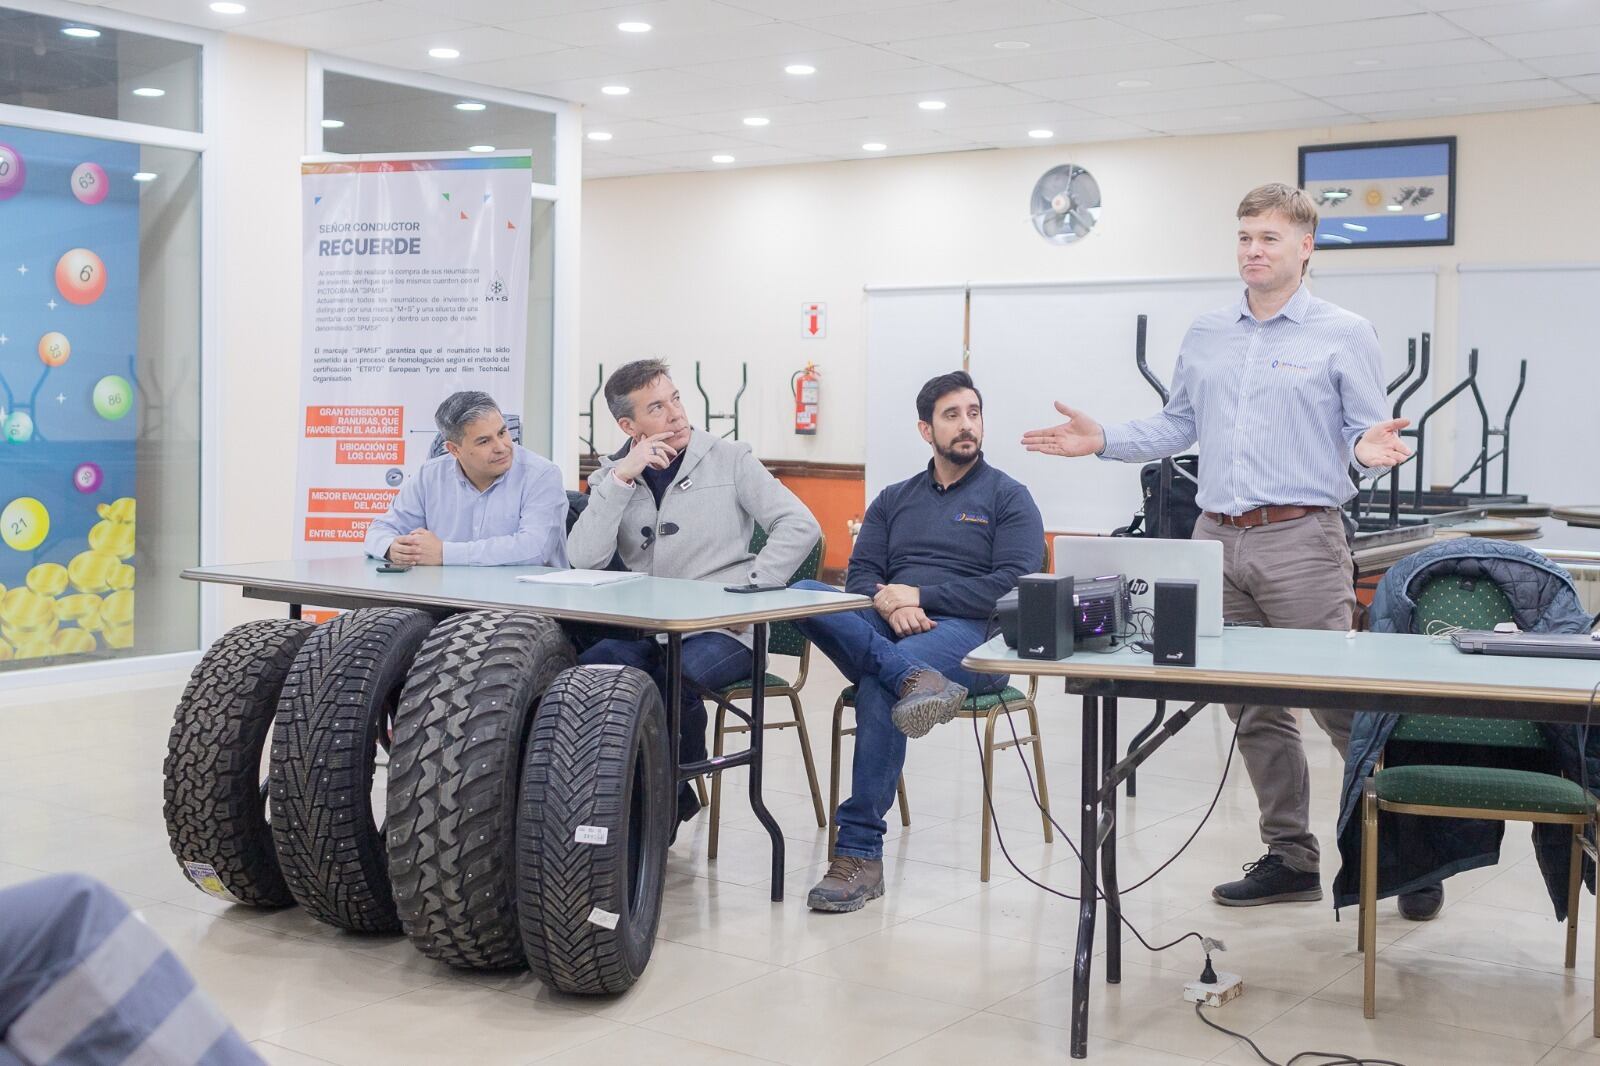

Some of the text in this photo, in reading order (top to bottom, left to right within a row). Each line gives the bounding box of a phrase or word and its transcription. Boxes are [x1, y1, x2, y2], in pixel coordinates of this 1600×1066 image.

[79, 172, 95, 189] 63
[319, 222, 420, 234] SEÑOR CONDUCTOR
[319, 238, 421, 256] RECUERDE
[80, 265, 93, 282] 6
[385, 347, 416, 355] garantiza
[397, 356, 445, 365] homologación
[388, 366, 421, 374] European
[425, 366, 440, 374] Tyre
[320, 408, 399, 416] GRAN DENSIDAD DE
[338, 417, 399, 426] RANURAS, QUE
[306, 426, 399, 434] FAVORECEN EL AGARRE
[340, 442, 385, 451] UBICACIÓN
[347, 452, 398, 460] LOS CLAVOS
[311, 491, 395, 500] MEJOR EVACUACIÓN
[11, 518, 28, 534] 21
[352, 521, 371, 529] DIST
[309, 530, 364, 538] ENTRE TACOS
[1130, 578, 1147, 595] hp
